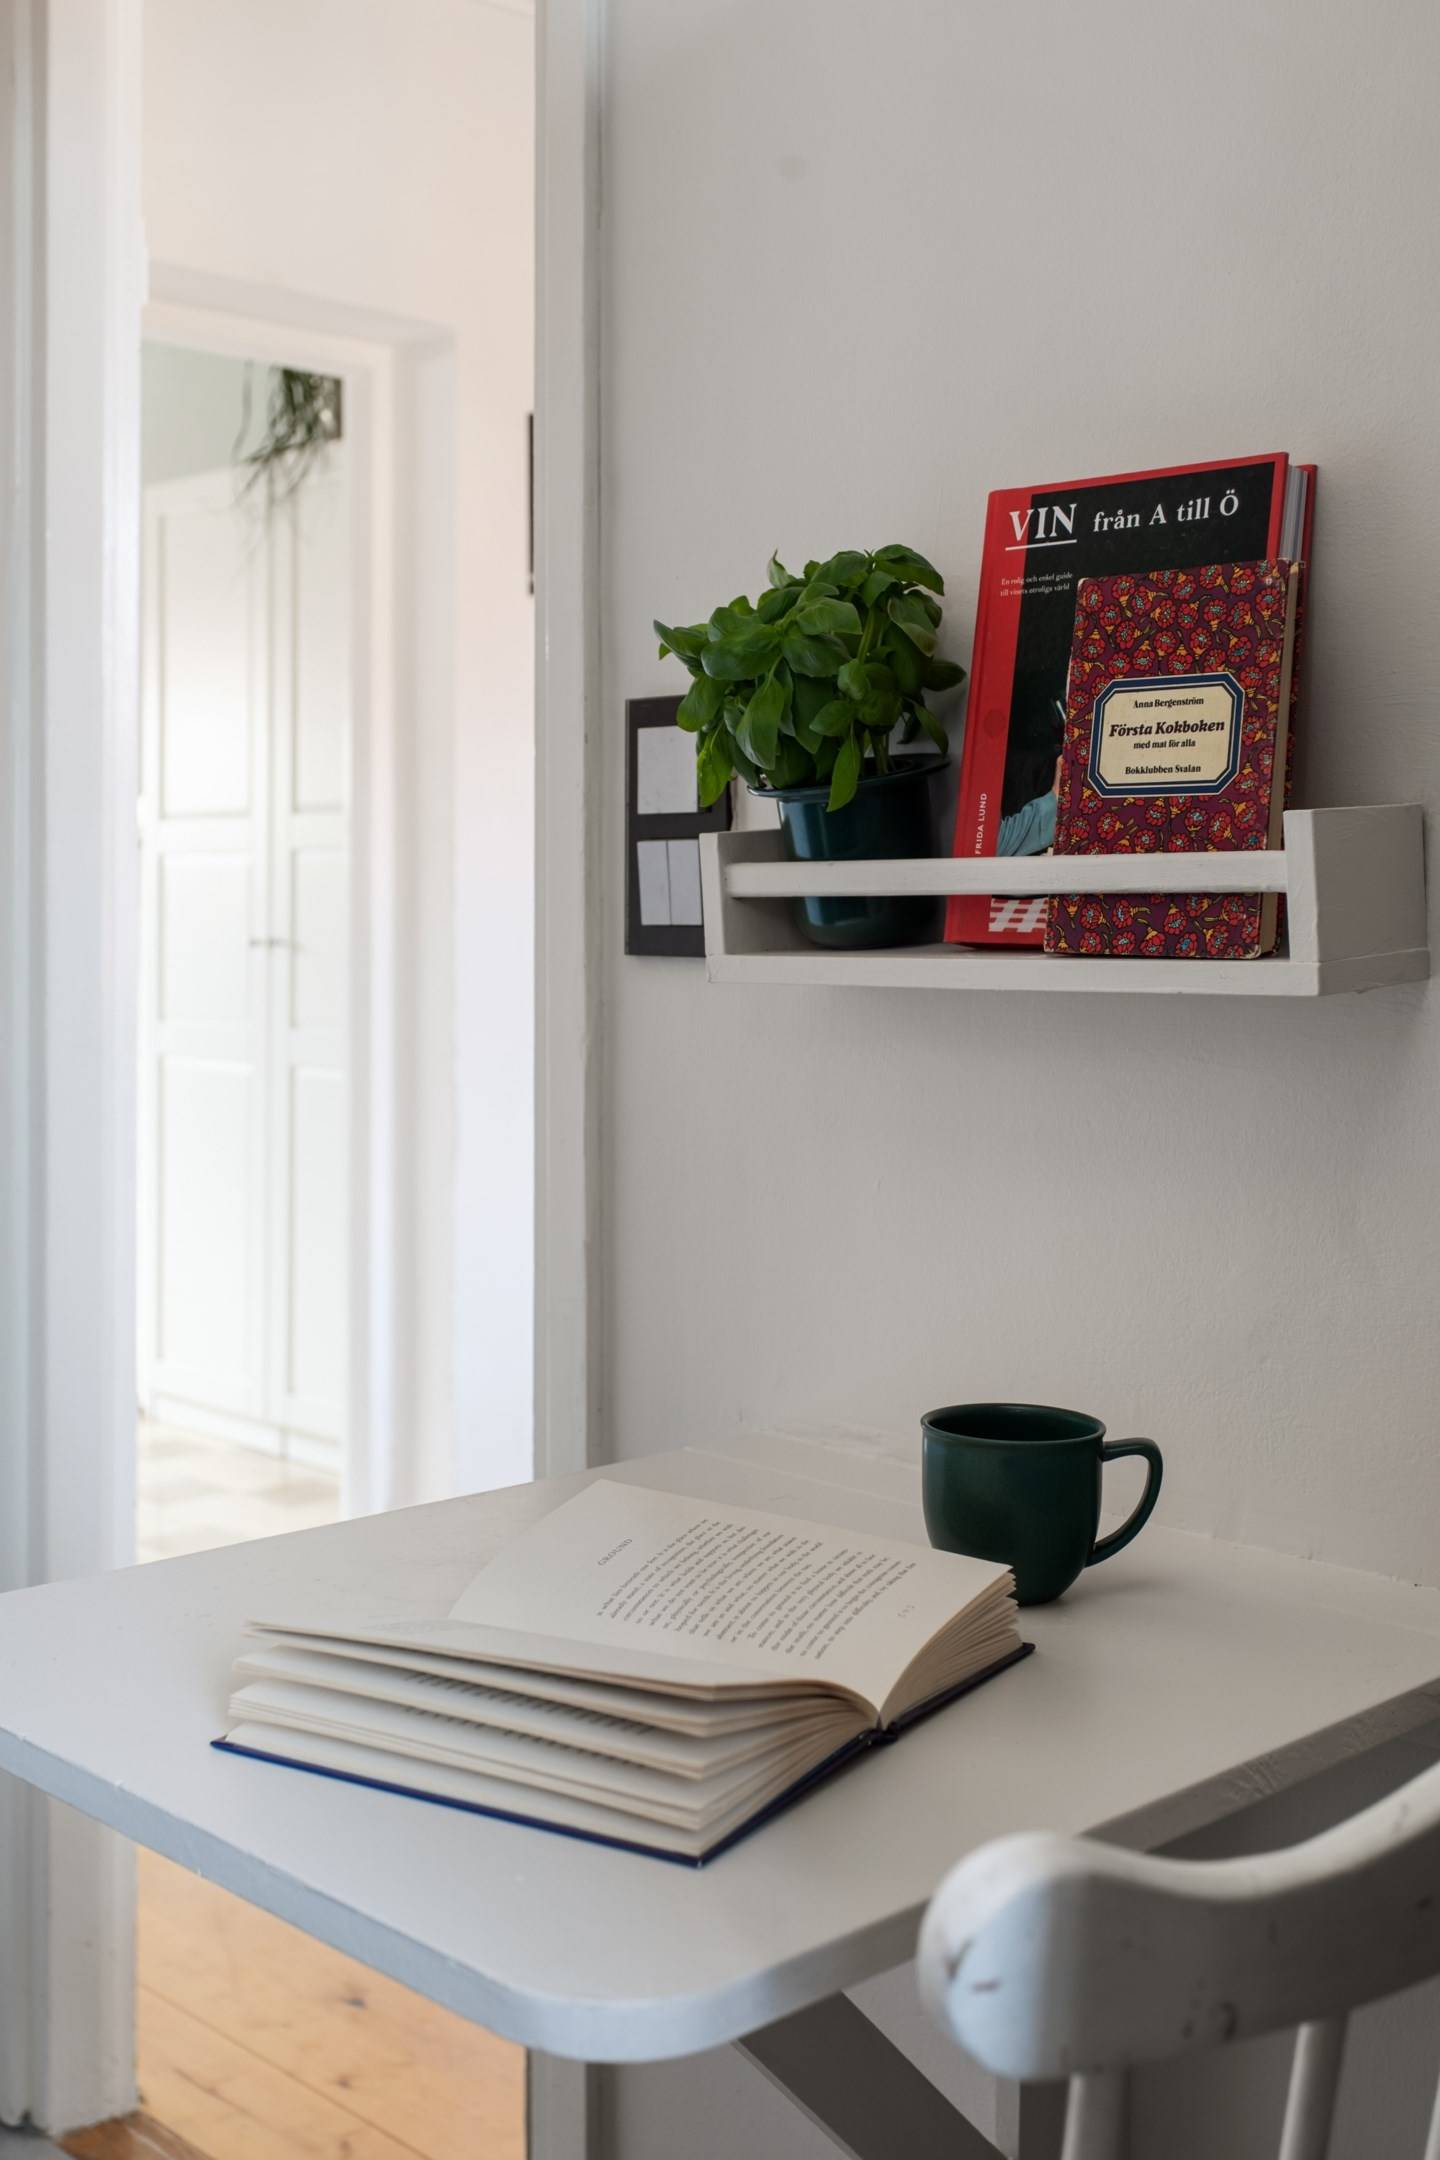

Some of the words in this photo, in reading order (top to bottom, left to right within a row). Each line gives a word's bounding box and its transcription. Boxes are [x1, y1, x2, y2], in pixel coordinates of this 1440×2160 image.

[1009, 503, 1078, 542] VIN
[1093, 508, 1141, 533] från
[1149, 503, 1168, 526] A
[1177, 496, 1212, 523] till
[1220, 488, 1240, 517] Ö
[1025, 575, 1038, 583] och
[1055, 571, 1073, 581] guide
[1133, 699, 1154, 709] Anna
[1154, 697, 1204, 709] Bergenström
[1109, 723, 1153, 737] Första
[1155, 719, 1225, 735] Kokboken
[1133, 740, 1151, 749] med
[1152, 740, 1167, 748] mat
[1168, 739, 1180, 748] för
[1181, 738, 1196, 747] alla
[1125, 766, 1174, 775] Bokklubben
[1175, 764, 1202, 773] Svalan
[978, 793, 987, 822] LUND
[975, 824, 984, 855] FRIDA
